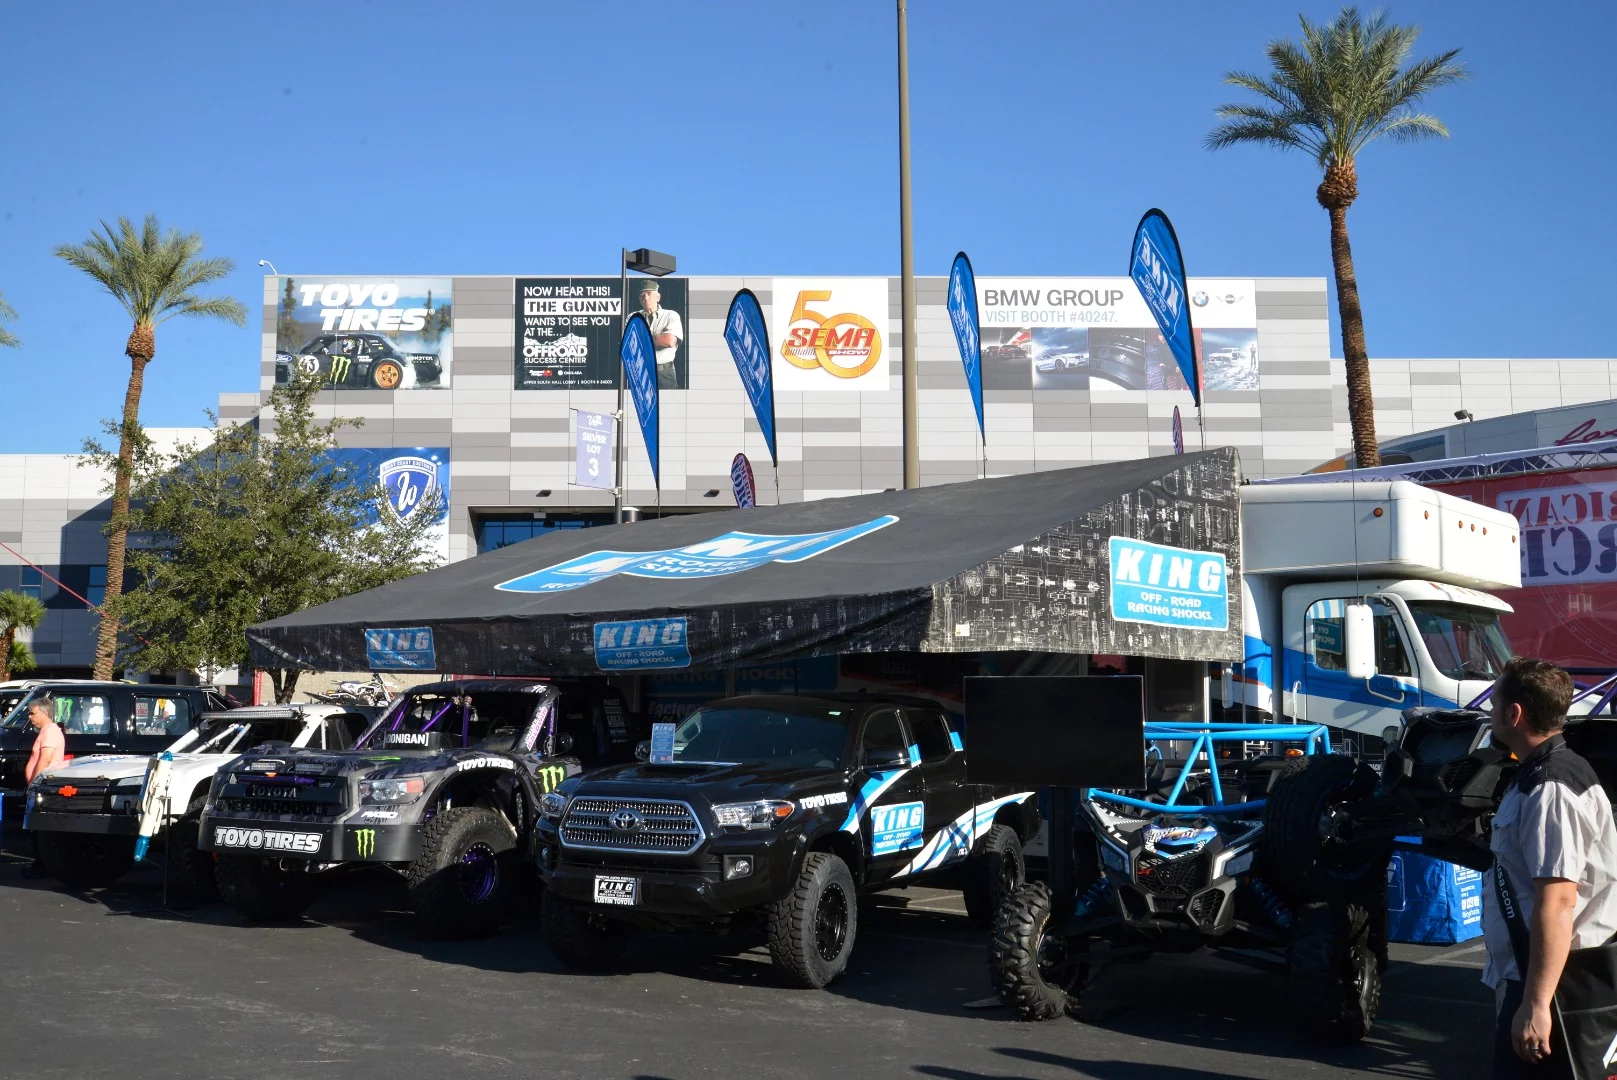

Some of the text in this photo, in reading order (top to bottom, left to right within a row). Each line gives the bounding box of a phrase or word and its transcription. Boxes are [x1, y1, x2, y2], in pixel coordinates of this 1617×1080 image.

[300, 284, 399, 307] TOYO
[524, 286, 611, 296] NOW HEAR THIS!
[984, 289, 1124, 307] BMW GROUP
[527, 301, 621, 312] THE GUNNY
[320, 308, 429, 331] TIRES
[524, 317, 610, 326] WANTS TO SEE YOU
[985, 310, 1018, 323] VISIT
[1021, 310, 1066, 323] BOOTH
[524, 327, 535, 336] AT
[787, 328, 876, 347] SEMA
[523, 345, 588, 357] OFFROAD
[582, 432, 607, 444] SILVER
[587, 444, 601, 455] LOT
[588, 457, 599, 477] 3
[1115, 547, 1222, 592] KING
[1140, 592, 1162, 604] OFF
[1170, 595, 1202, 608] ROAD
[1127, 602, 1170, 617] RACING
[370, 631, 430, 651] KING
[599, 622, 683, 648] KING
[640, 656, 676, 665] SHOCKS
[457, 758, 514, 771] TOYO TIRES
[251, 784, 297, 798] TOYOTA
[799, 794, 824, 810] TOYO
[873, 806, 922, 833] KING
[215, 827, 322, 853] TOYO TIRES
[600, 881, 633, 891] KING
